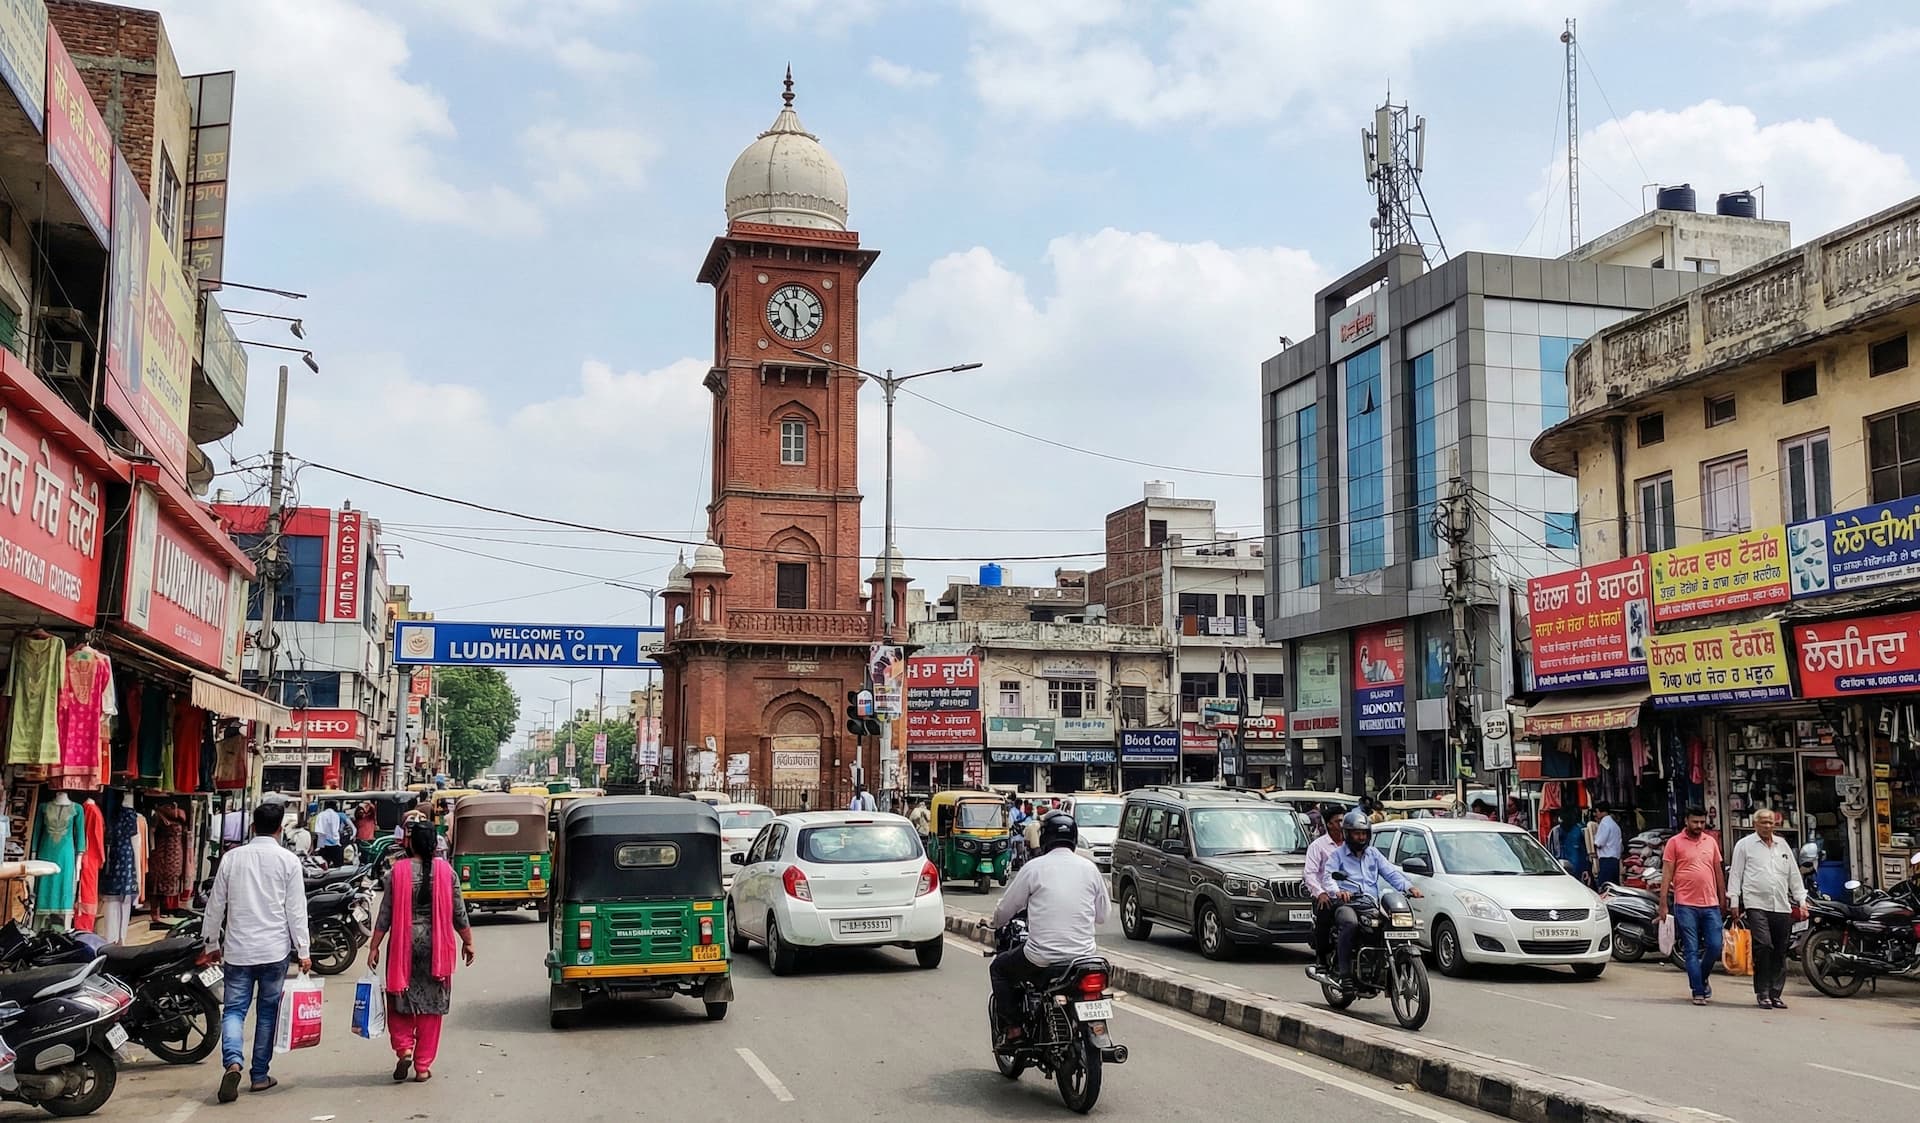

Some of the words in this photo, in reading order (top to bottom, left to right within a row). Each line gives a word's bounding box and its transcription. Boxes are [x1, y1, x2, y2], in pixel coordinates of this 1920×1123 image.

[490, 627, 561, 640] WELCOME
[565, 630, 585, 640] TO
[449, 641, 565, 661] LUDHIANA
[571, 645, 623, 661] CITY
